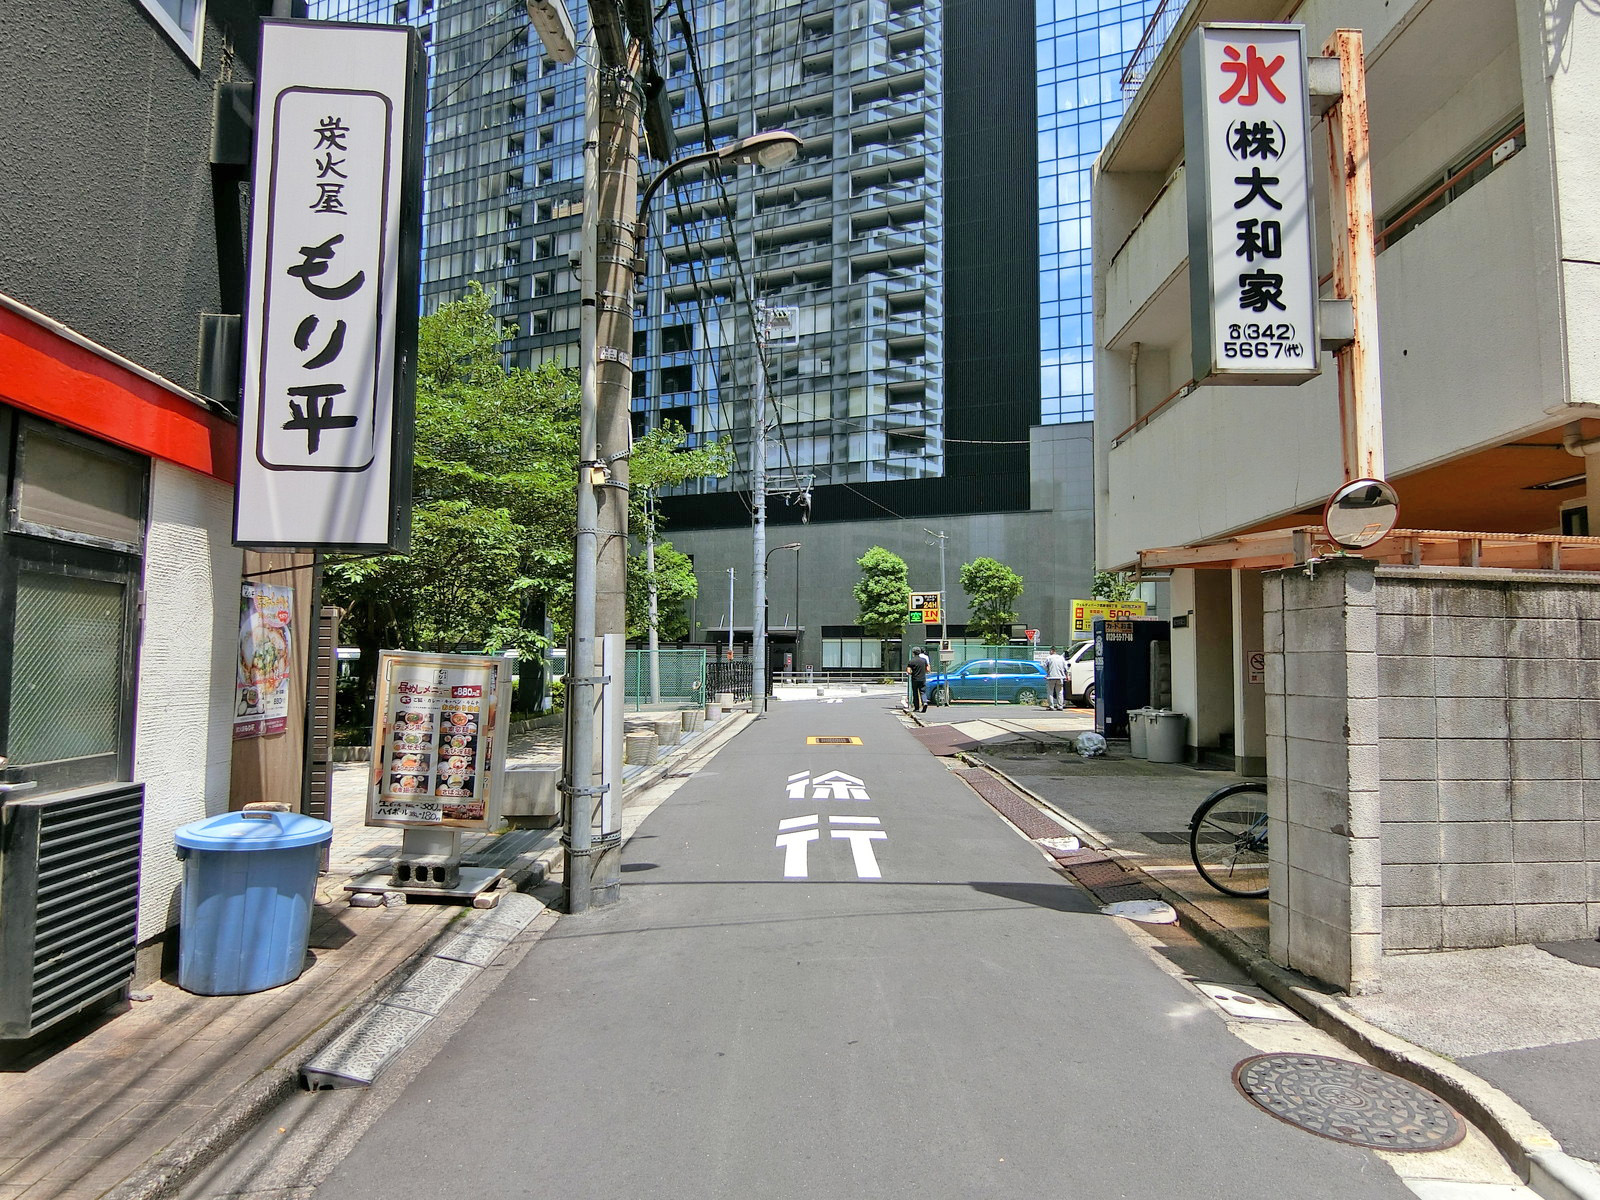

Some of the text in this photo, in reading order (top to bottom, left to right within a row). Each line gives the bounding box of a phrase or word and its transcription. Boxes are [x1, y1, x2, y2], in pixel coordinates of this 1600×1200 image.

[1219, 45, 1287, 106] 氷
[309, 115, 350, 215] 炭火屋
[1225, 119, 1288, 313] (株)大和家
[281, 233, 366, 455] もり平
[912, 596, 924, 609] P
[923, 601, 937, 609] 24H
[398, 681, 449, 696] 昼めしメニュー
